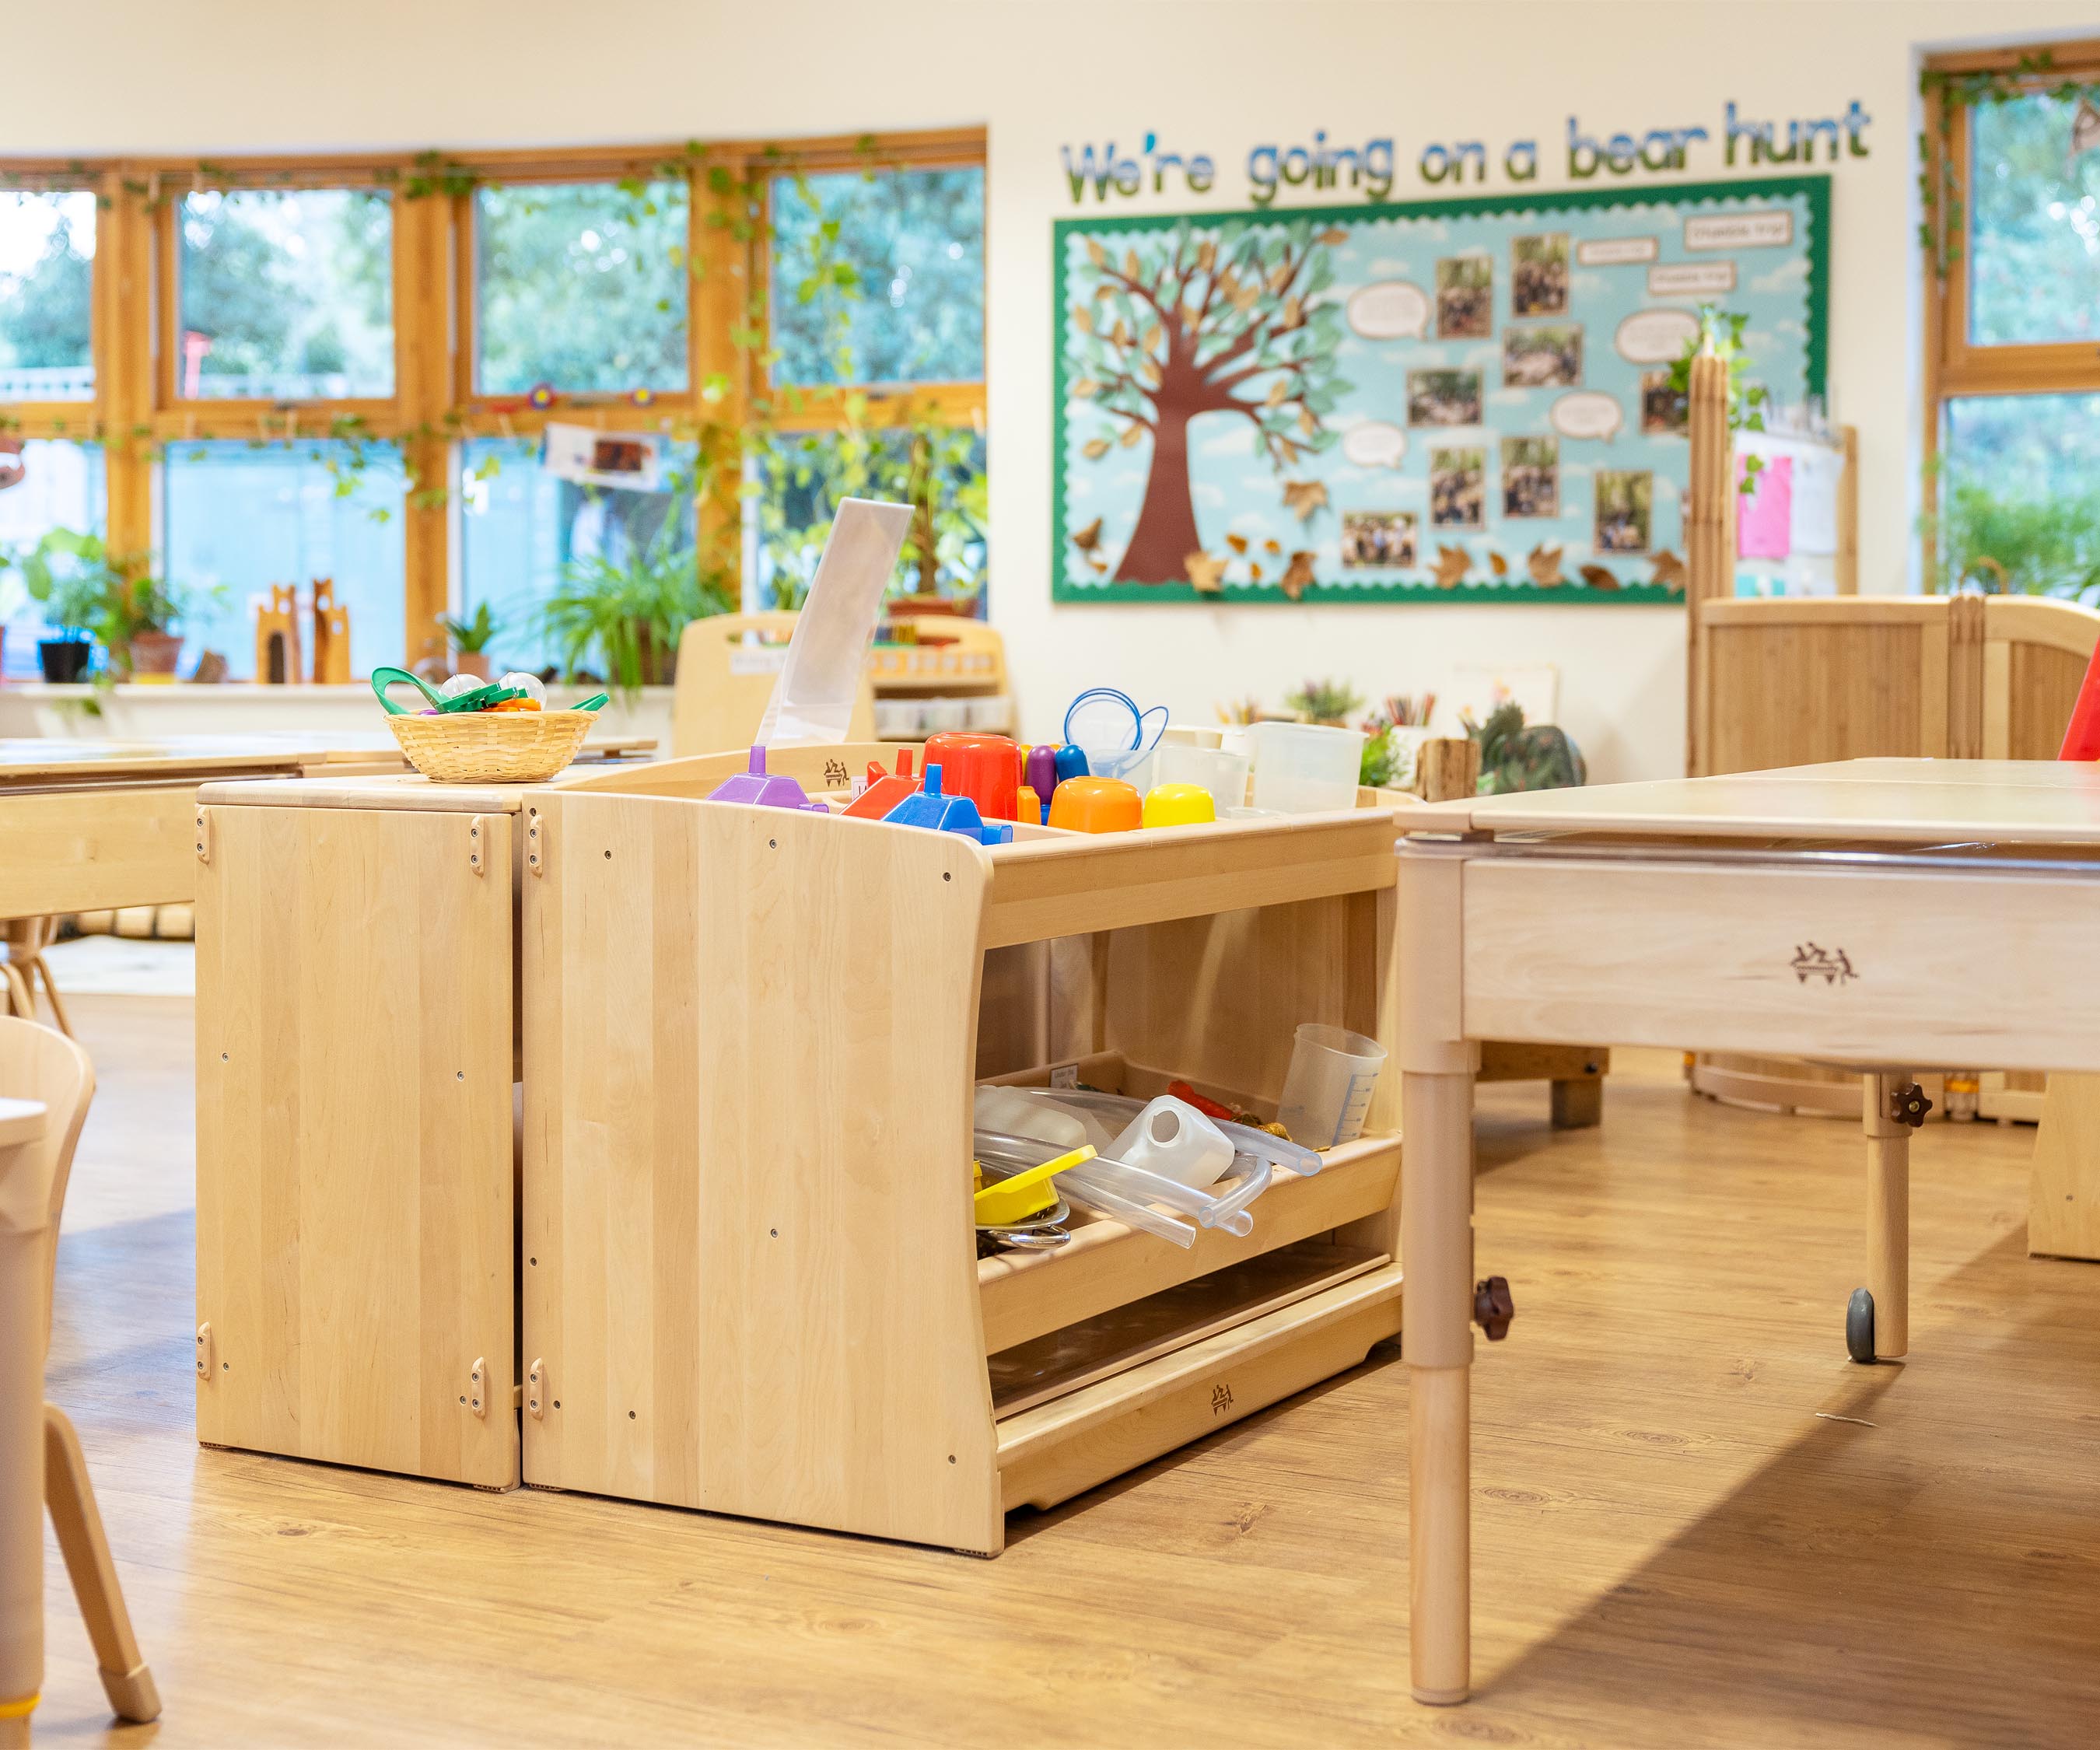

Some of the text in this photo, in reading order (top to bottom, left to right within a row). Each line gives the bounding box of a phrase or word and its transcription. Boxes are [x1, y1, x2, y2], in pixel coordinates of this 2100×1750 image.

[1062, 100, 1871, 207] We're going on a bear hunt
